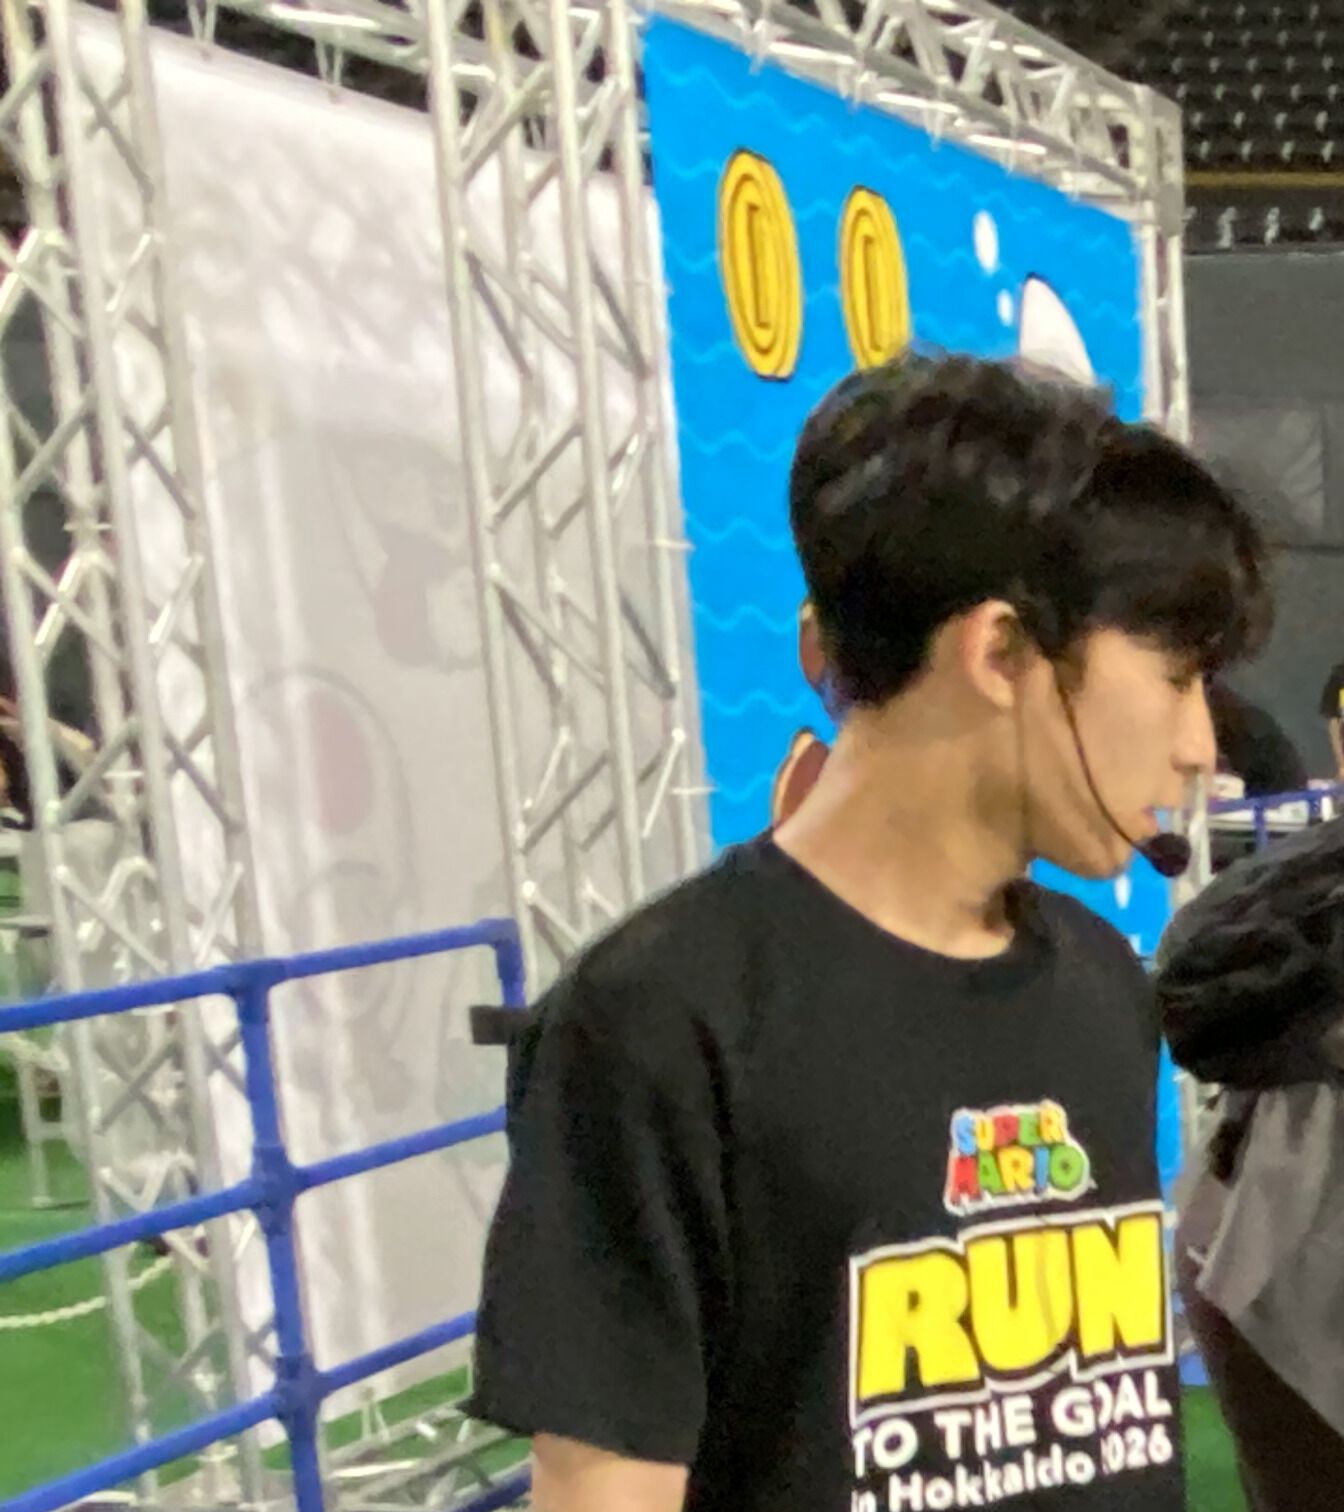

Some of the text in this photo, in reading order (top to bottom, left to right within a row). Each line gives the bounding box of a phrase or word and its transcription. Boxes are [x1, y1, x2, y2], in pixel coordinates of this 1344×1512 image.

[954, 1104, 1067, 1156] SUPER
[949, 1143, 1086, 1207] MARIO
[855, 1212, 1168, 1403] RUN
[852, 1418, 919, 1478] TO
[934, 1393, 1038, 1459] THE
[1101, 1424, 1173, 1474] 026
